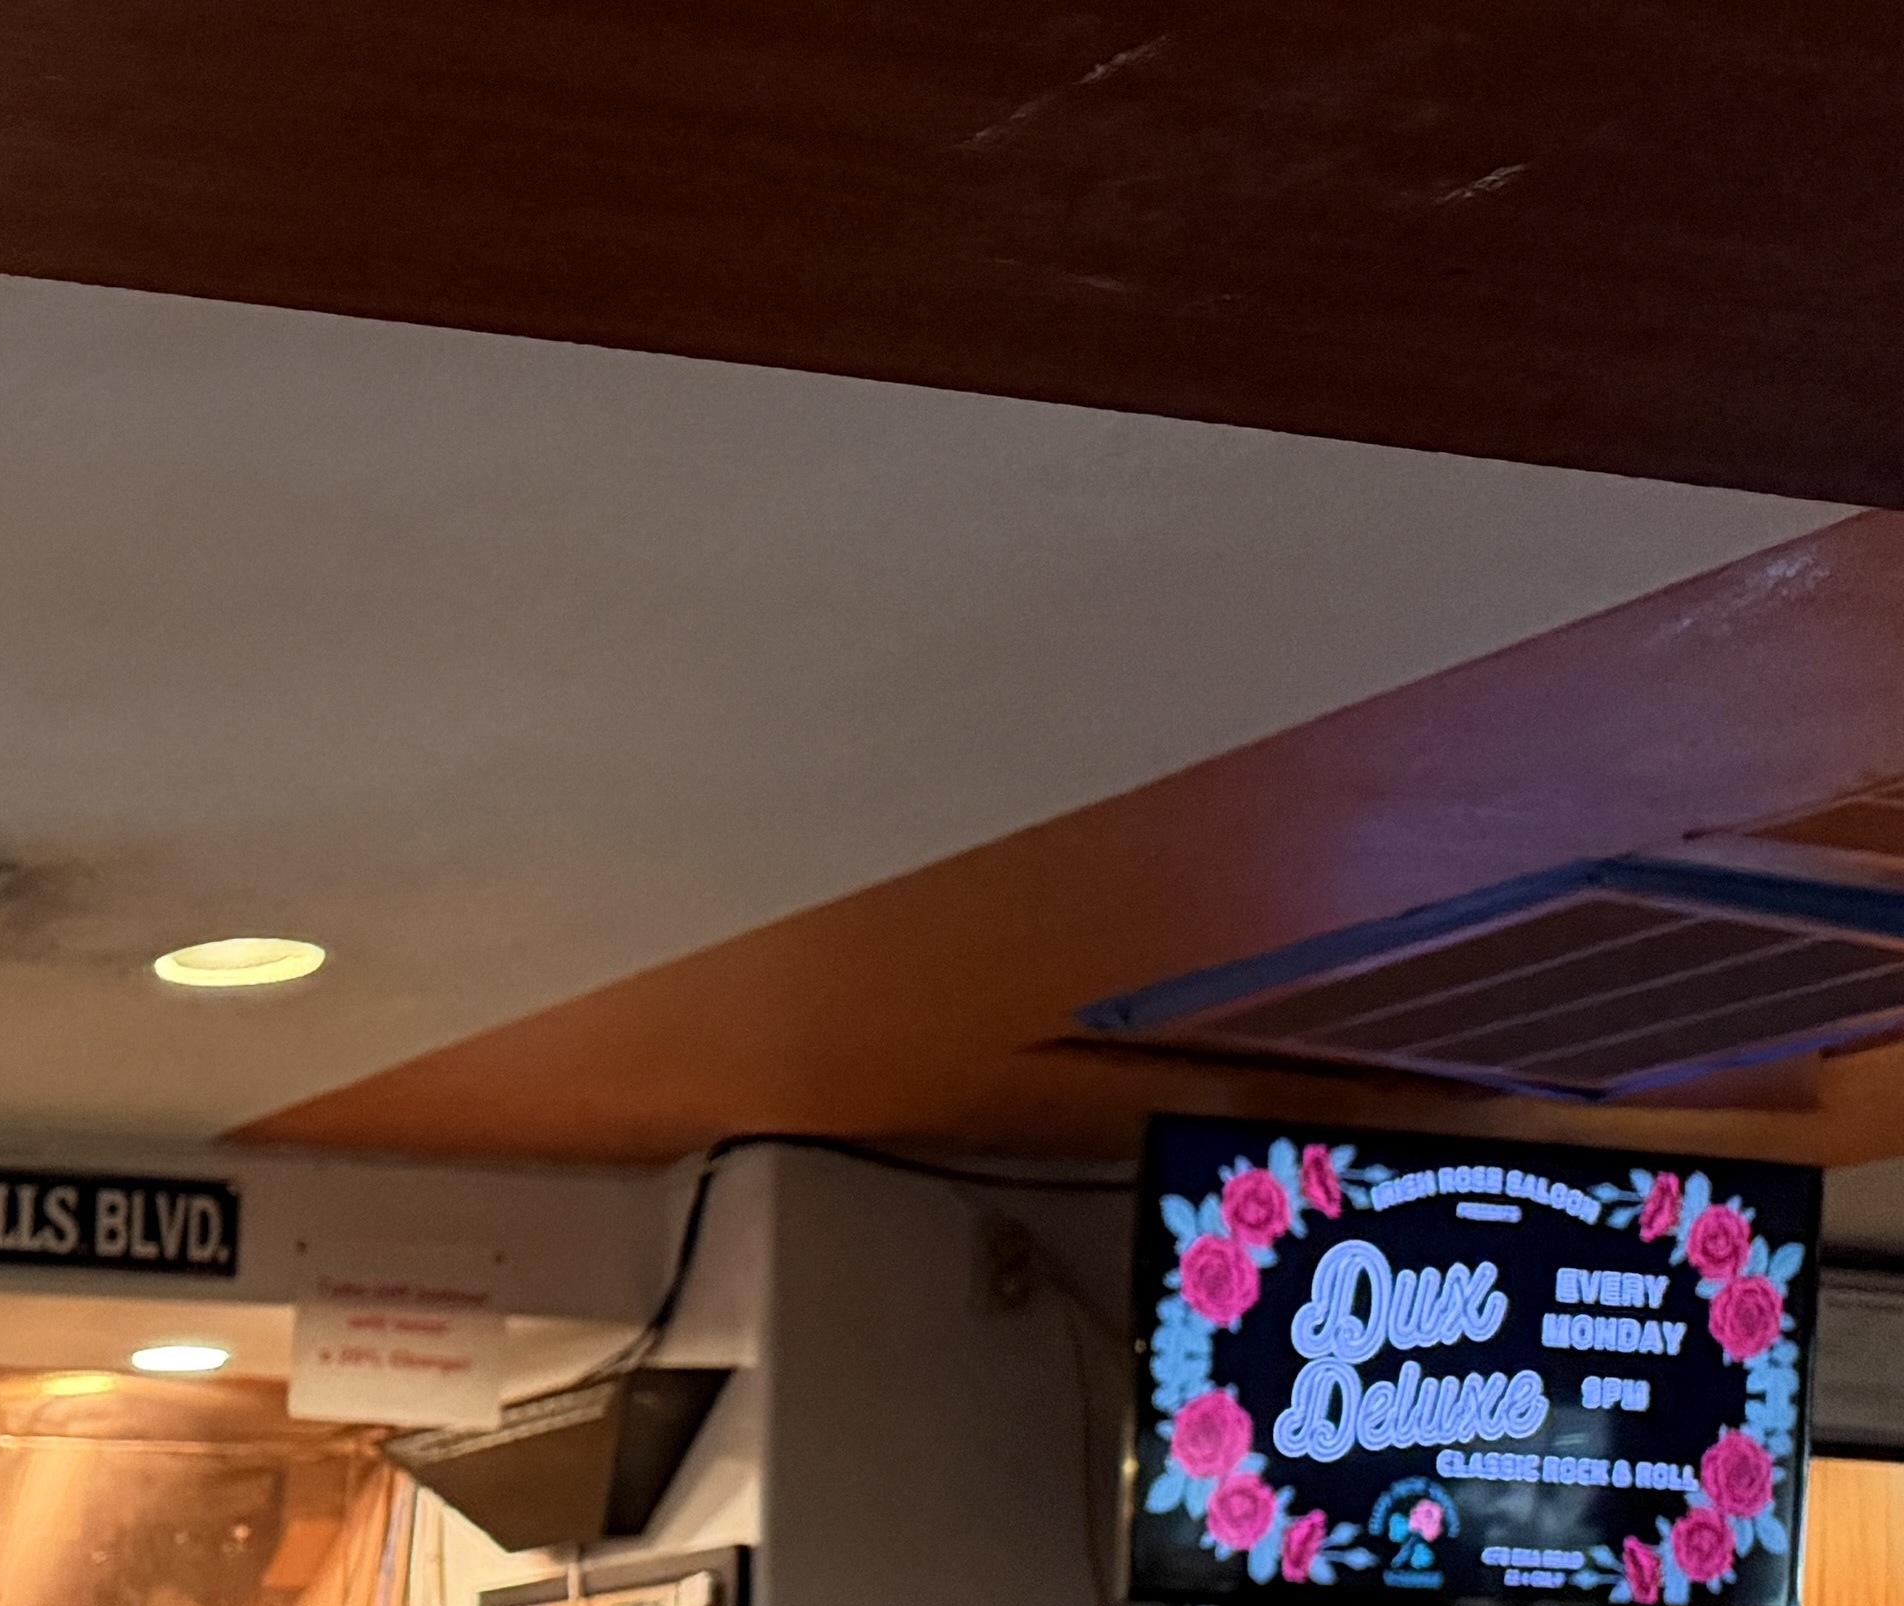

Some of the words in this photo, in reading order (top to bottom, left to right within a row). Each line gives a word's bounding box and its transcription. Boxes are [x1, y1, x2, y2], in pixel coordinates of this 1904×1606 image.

[94, 1188, 232, 1265] BLVD.
[1438, 1166, 1504, 1195] ROSE
[1505, 1169, 1602, 1226] SALOON
[1291, 1239, 1509, 1364] Dux
[1554, 1267, 1671, 1309] EVERY
[1541, 1313, 1688, 1356] MONDAY
[1273, 1356, 1550, 1463] Deluxe
[1435, 1448, 1541, 1482] CLASSIC
[1542, 1455, 1610, 1487] ROCK
[1635, 1461, 1700, 1492] ROLL
